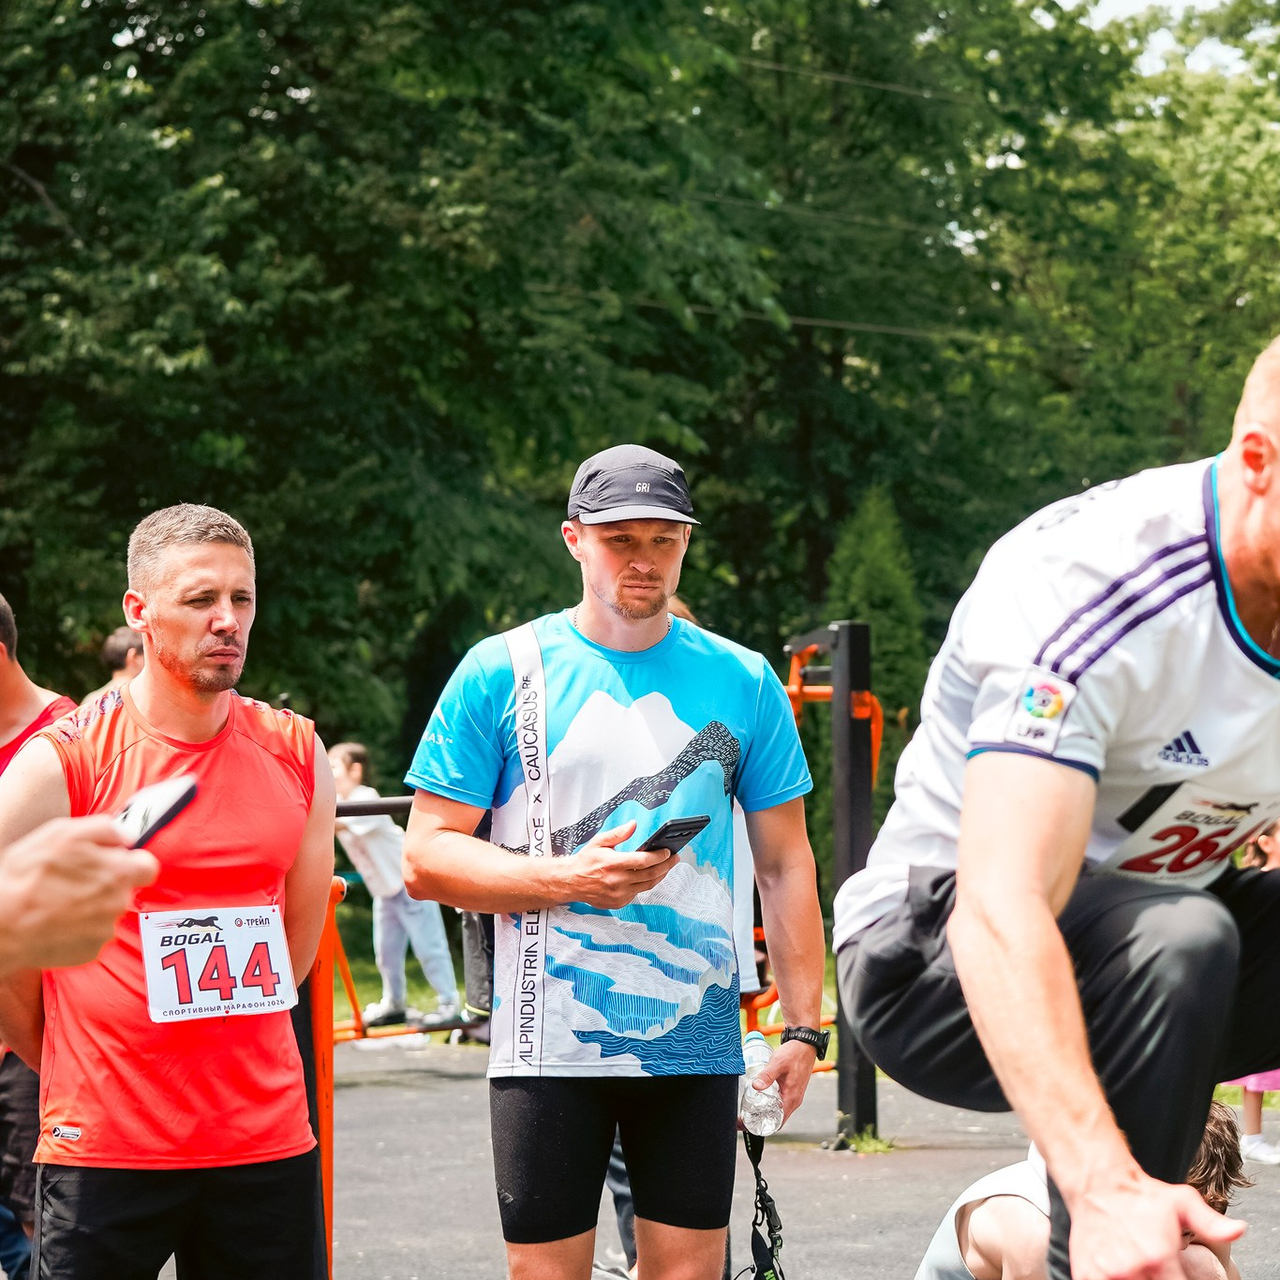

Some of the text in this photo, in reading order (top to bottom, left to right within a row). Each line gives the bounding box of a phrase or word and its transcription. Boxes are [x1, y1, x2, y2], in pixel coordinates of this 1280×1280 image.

[522, 690, 541, 781] CAUCASUS
[1157, 749, 1209, 767] adidas
[1174, 810, 1248, 826] BOGAL
[160, 932, 224, 947] BOGAL
[161, 942, 281, 1005] 144
[162, 1005, 222, 1017] СПОРТИВНЫЙ
[223, 1001, 265, 1012] МАРАФОН
